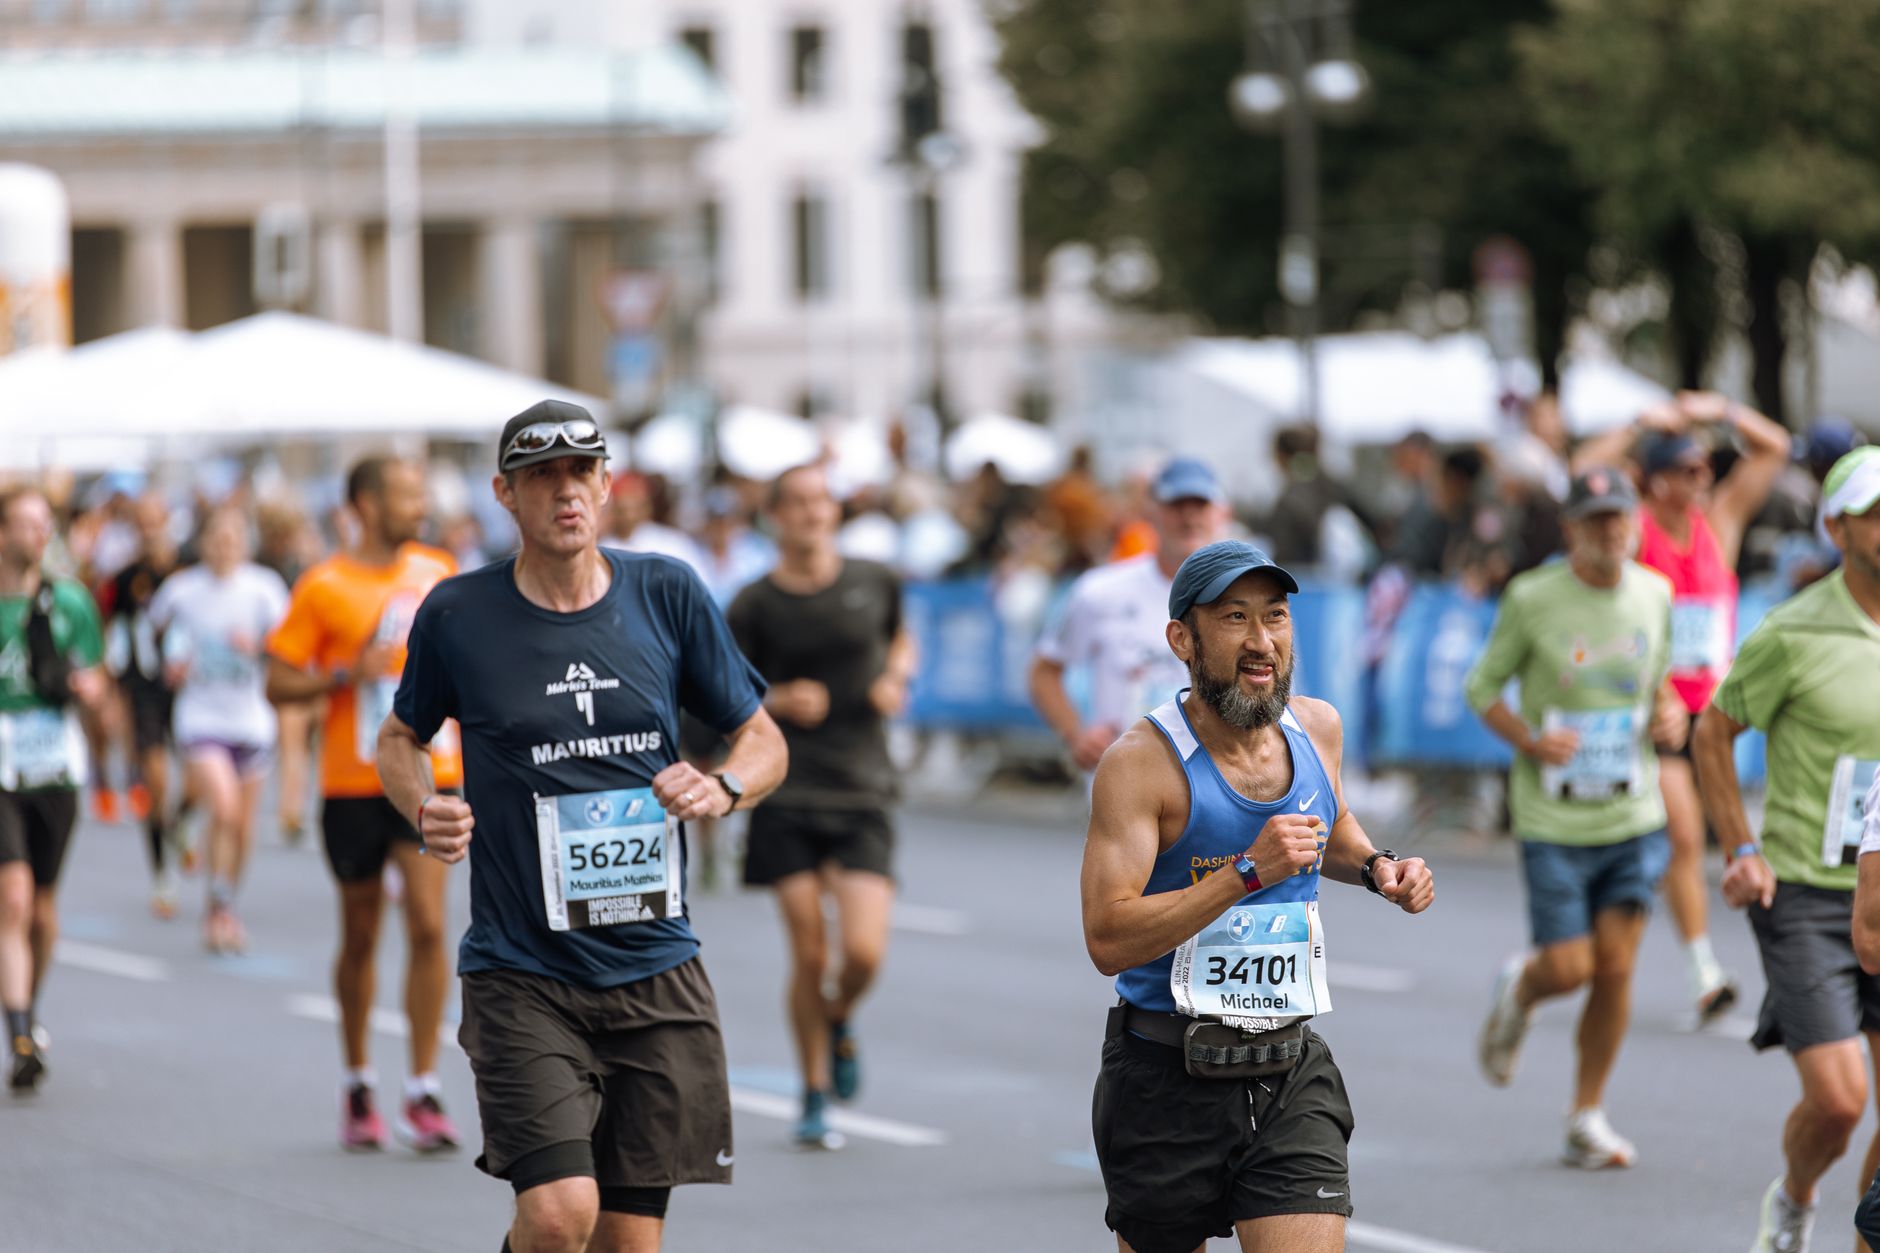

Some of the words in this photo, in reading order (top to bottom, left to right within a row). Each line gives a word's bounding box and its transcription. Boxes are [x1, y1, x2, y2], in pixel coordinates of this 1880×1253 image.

[531, 731, 661, 765] MAURITIUS
[569, 836, 661, 871] 56224
[588, 894, 642, 913] IMPOSSIBLE
[589, 911, 601, 926] IS
[601, 906, 641, 925] NOTHING
[1313, 946, 1322, 959] E
[1182, 966, 1190, 984] 2022
[1206, 953, 1297, 986] 34101
[1220, 993, 1289, 1010] Michael
[1222, 1015, 1280, 1031] IMPOSSIBLE
